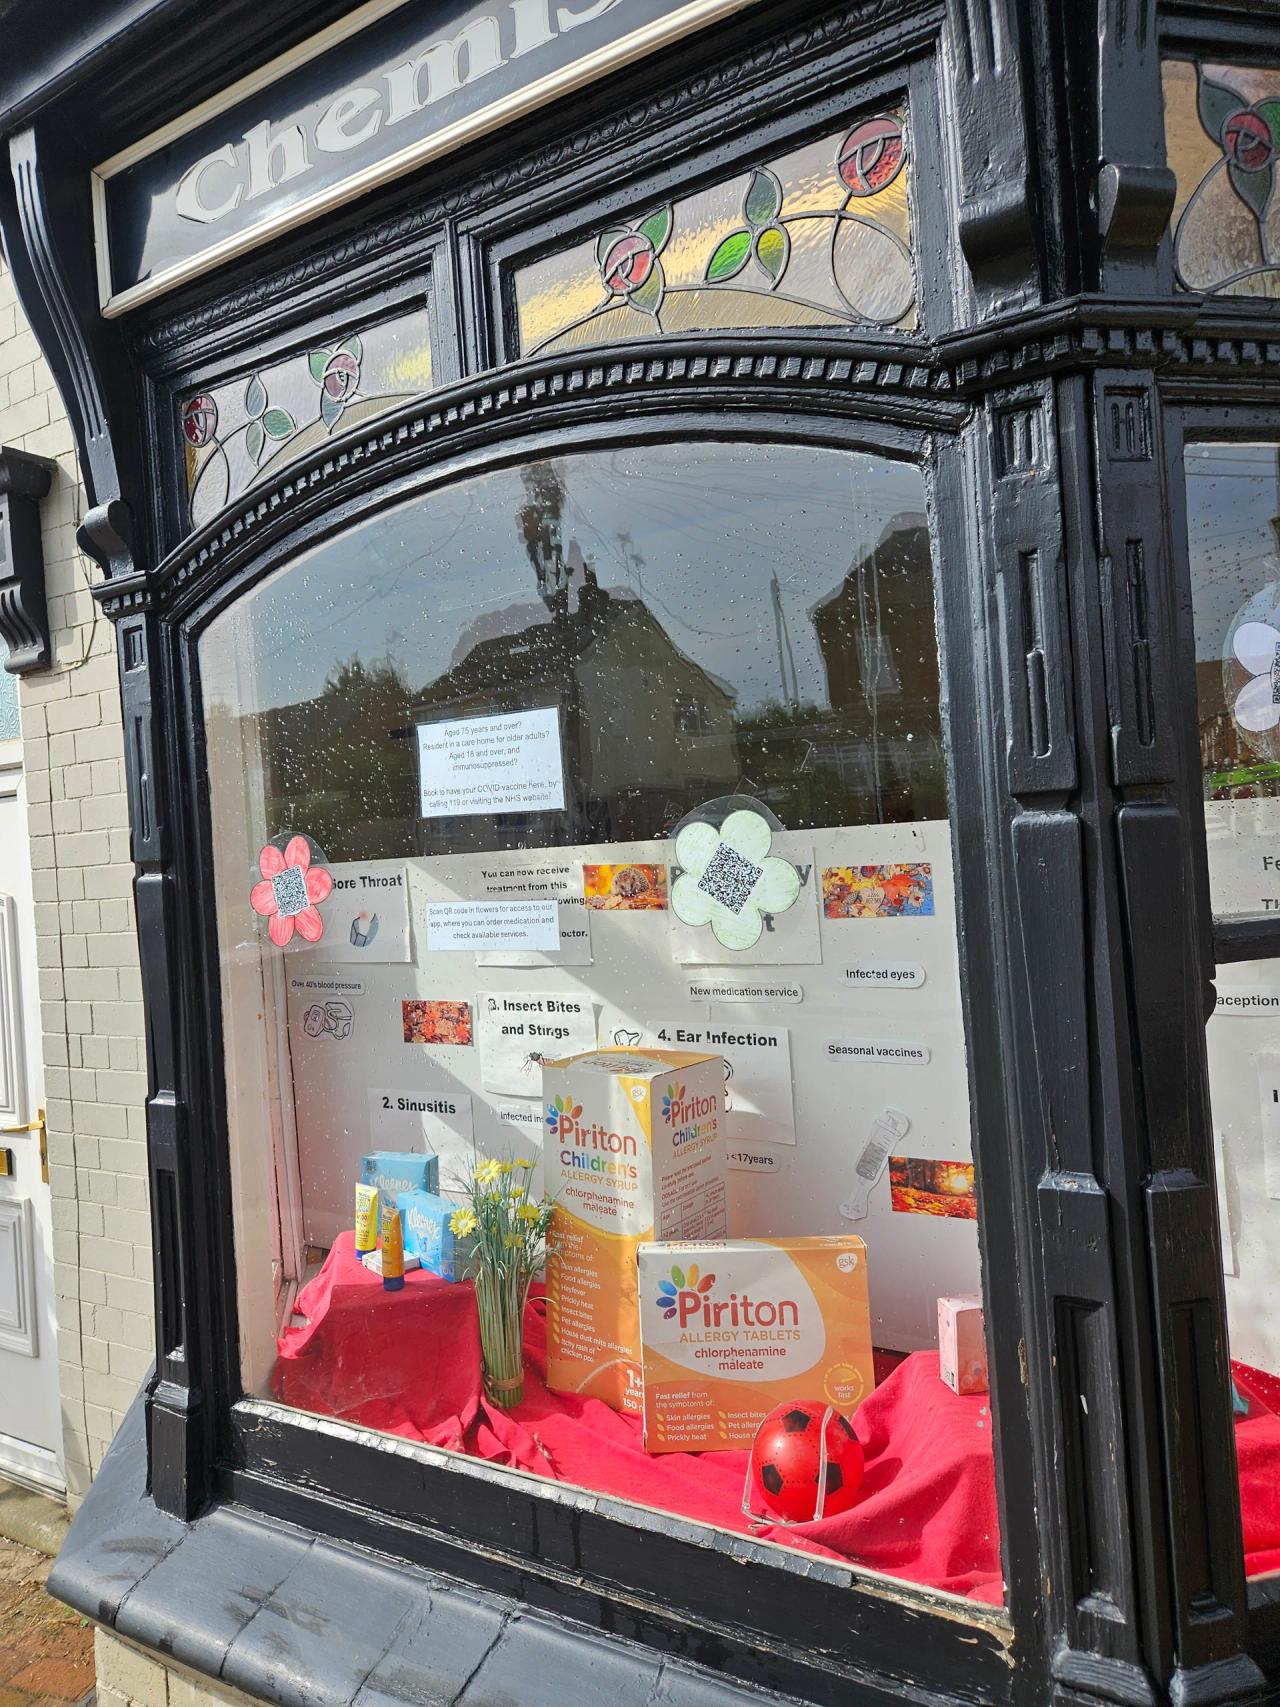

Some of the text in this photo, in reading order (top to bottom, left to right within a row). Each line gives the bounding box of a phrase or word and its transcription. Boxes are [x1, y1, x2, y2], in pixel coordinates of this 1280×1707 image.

[445, 729, 460, 737] Aged
[461, 726, 470, 735] 75
[471, 725, 489, 735] years
[503, 721, 522, 730] over?
[423, 741, 449, 750] Resident
[506, 734, 524, 742] older
[525, 730, 550, 740] adults?
[449, 752, 465, 760] Aged
[476, 749, 488, 757] and
[507, 746, 520, 754] and
[452, 758, 518, 770] immunosuppressed?
[423, 788, 437, 796] Book
[462, 787, 476, 795] your
[477, 784, 499, 792] COVID
[501, 782, 527, 790] vaccine
[548, 780, 557, 789] by
[429, 799, 448, 809] calling
[470, 796, 492, 805] visiting
[493, 795, 504, 803] the
[505, 794, 521, 802] NHS
[481, 870, 498, 878] You
[516, 869, 534, 877] now
[536, 866, 570, 875] receive
[359, 874, 403, 888] Throat
[486, 881, 568, 893] treatment from this
[443, 907, 453, 915] QR
[475, 905, 499, 913] flowers
[509, 904, 533, 912] access
[430, 920, 443, 928] app,
[443, 918, 461, 927] where
[461, 919, 473, 928] you
[485, 918, 503, 926] order
[503, 916, 540, 925] medication
[541, 916, 555, 924] and
[452, 931, 471, 939] check
[471, 930, 500, 939] available
[559, 930, 589, 938] octor.
[845, 968, 916, 982] Infected eyes
[291, 979, 304, 988] Over
[317, 981, 335, 989] blood
[334, 983, 362, 991] pressure
[689, 986, 799, 997] New medication service
[503, 999, 543, 1012] Insect
[546, 1001, 582, 1013] Bites
[501, 1024, 571, 1040] and Stings
[657, 1028, 778, 1047] 4. Ear Infection
[828, 1044, 924, 1058] Seasonal vaccines
[382, 1096, 456, 1114] 2. Sinusitis
[670, 1095, 717, 1128] Piriton
[500, 1111, 533, 1123] Infected
[558, 1115, 637, 1157] Piriton
[672, 1118, 718, 1147] Children's
[672, 1141, 699, 1160] ALLERGY
[559, 1150, 638, 1179] Children's
[560, 1169, 638, 1191] ALLERGY SYRUP
[565, 1186, 635, 1210] chlorphenamine
[582, 1201, 618, 1216] maleate
[566, 1233, 584, 1243] relief
[838, 1256, 856, 1269] gsk
[574, 1265, 598, 1278] allergies
[560, 1273, 601, 1290] Food allergies
[580, 1300, 594, 1310] heat
[678, 1290, 799, 1329] Piriton
[561, 1305, 593, 1321] Insect bites
[561, 1316, 596, 1333] Pet allergies
[561, 1327, 579, 1338] House
[579, 1333, 593, 1342] dust
[607, 1341, 633, 1355] allergies
[679, 1329, 801, 1344] ALLERGY TABLETS
[561, 1347, 583, 1359] chicken
[575, 1343, 588, 1352] rash
[694, 1346, 787, 1360] chlorphenamine
[718, 1359, 765, 1371] maleate
[625, 1388, 643, 1398] year
[672, 1391, 691, 1399] relief
[691, 1391, 708, 1399] from
[623, 1397, 637, 1410] 150
[669, 1400, 705, 1409] symptoms
[666, 1413, 712, 1423] Skin allergies
[749, 1411, 767, 1419] bites
[686, 1423, 715, 1432] allergies
[728, 1421, 761, 1430] Pet allerg
[667, 1433, 708, 1442] Prickly heat
[728, 1432, 752, 1440] House
